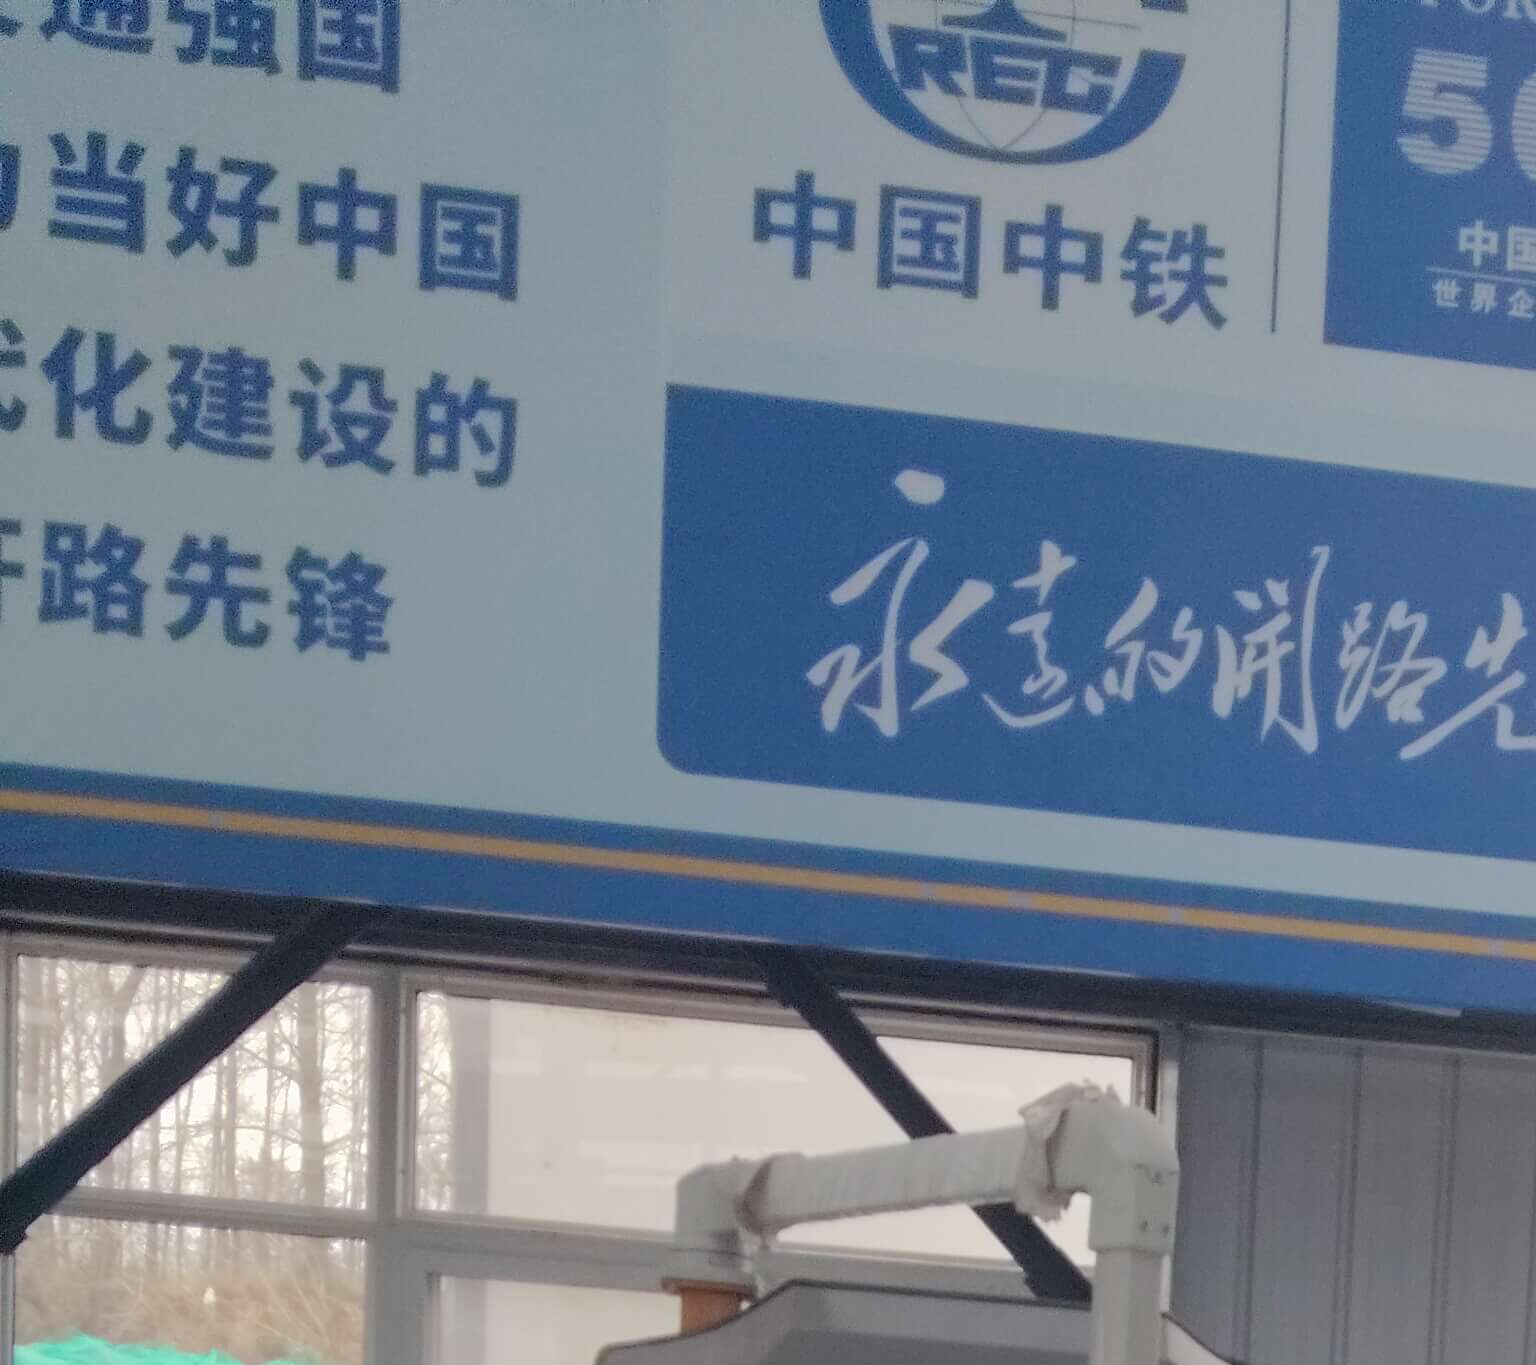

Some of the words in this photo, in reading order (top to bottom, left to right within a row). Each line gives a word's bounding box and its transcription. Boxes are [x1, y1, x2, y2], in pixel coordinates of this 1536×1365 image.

[0, 0, 400, 94] 强国
[0, 132, 520, 301] 当好中国
[753, 169, 1229, 331] 中国中铁
[0, 318, 518, 488] 化建设的
[0, 519, 395, 661] 路先锋
